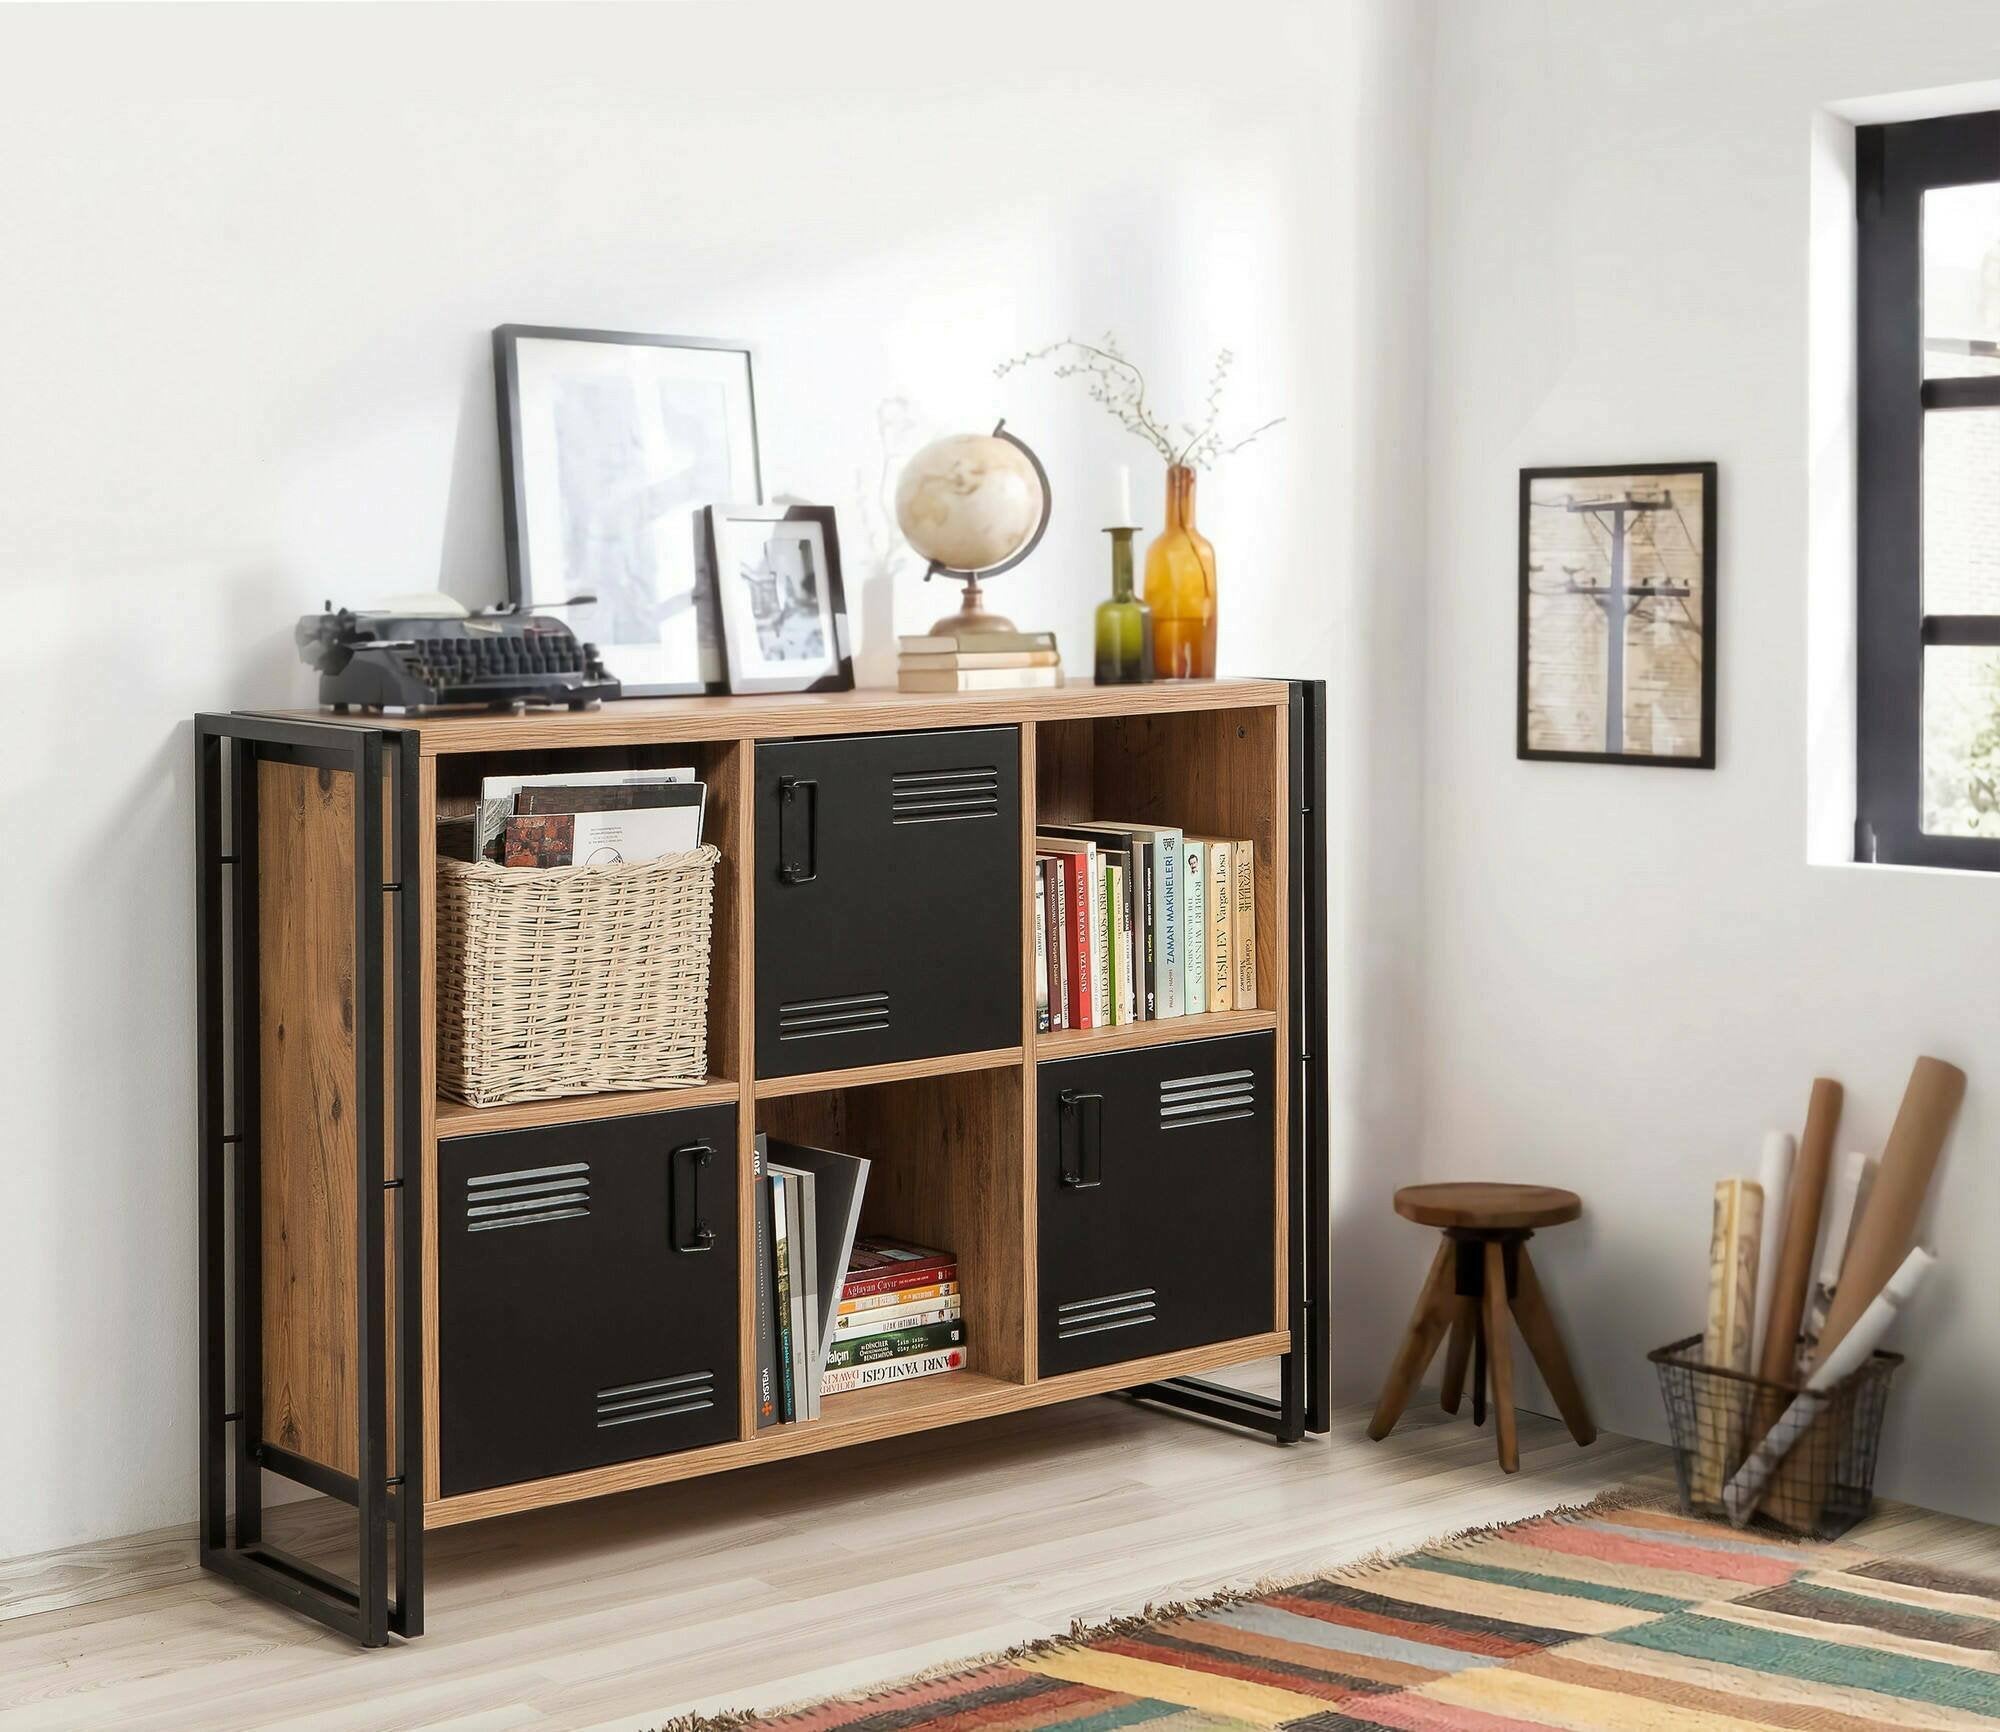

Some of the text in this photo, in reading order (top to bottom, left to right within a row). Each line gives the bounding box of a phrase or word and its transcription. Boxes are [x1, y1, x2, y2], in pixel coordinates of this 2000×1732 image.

[1194, 881, 1202, 924] ROBERT
[1216, 854, 1228, 923] Vargas Llosa
[1244, 862, 1252, 912] YÜZYILLIK
[1164, 856, 1174, 964] ZAMAN MAKİNELERİ
[1080, 951, 1088, 993] SUN-TZU
[1216, 929, 1228, 992] YEŞİL EV
[848, 1280, 897, 1296] Ağlayan Çayır
[762, 1368, 770, 1402] SYSTEM
[822, 1370, 860, 1384] DAWKIN
[862, 1361, 918, 1383] YANILGISI
